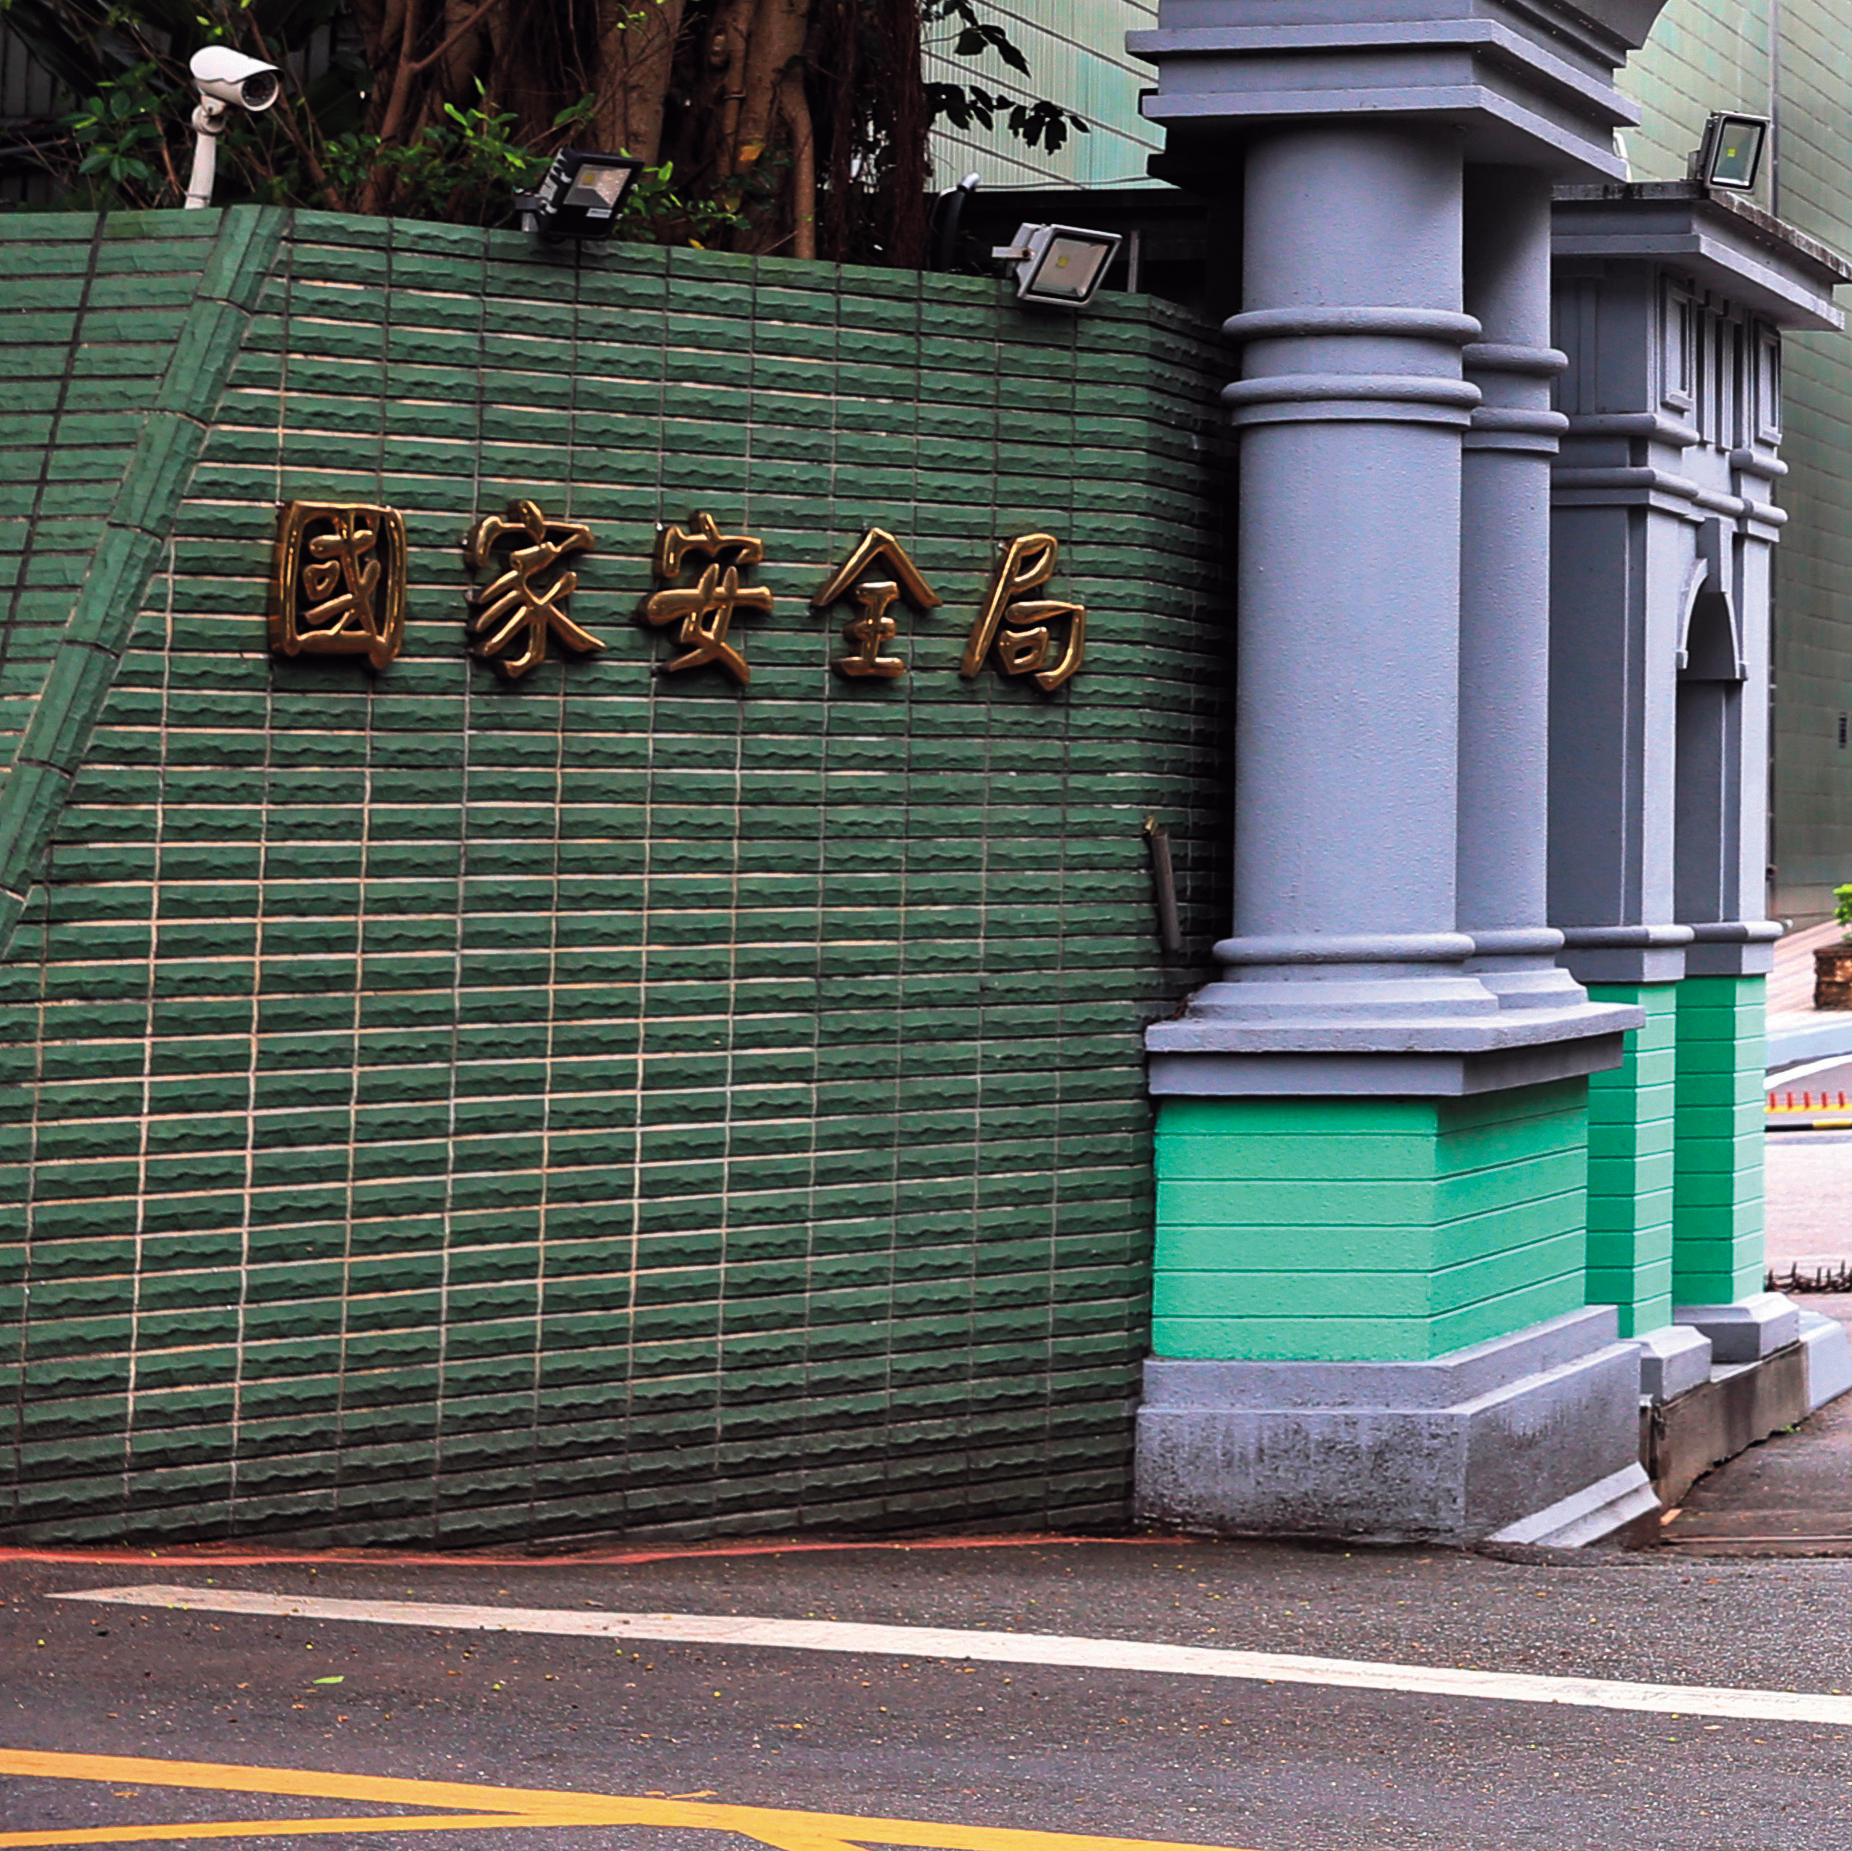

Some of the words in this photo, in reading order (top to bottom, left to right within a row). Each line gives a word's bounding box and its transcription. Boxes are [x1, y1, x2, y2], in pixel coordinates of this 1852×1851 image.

[269, 500, 1085, 691] 國家安全局
